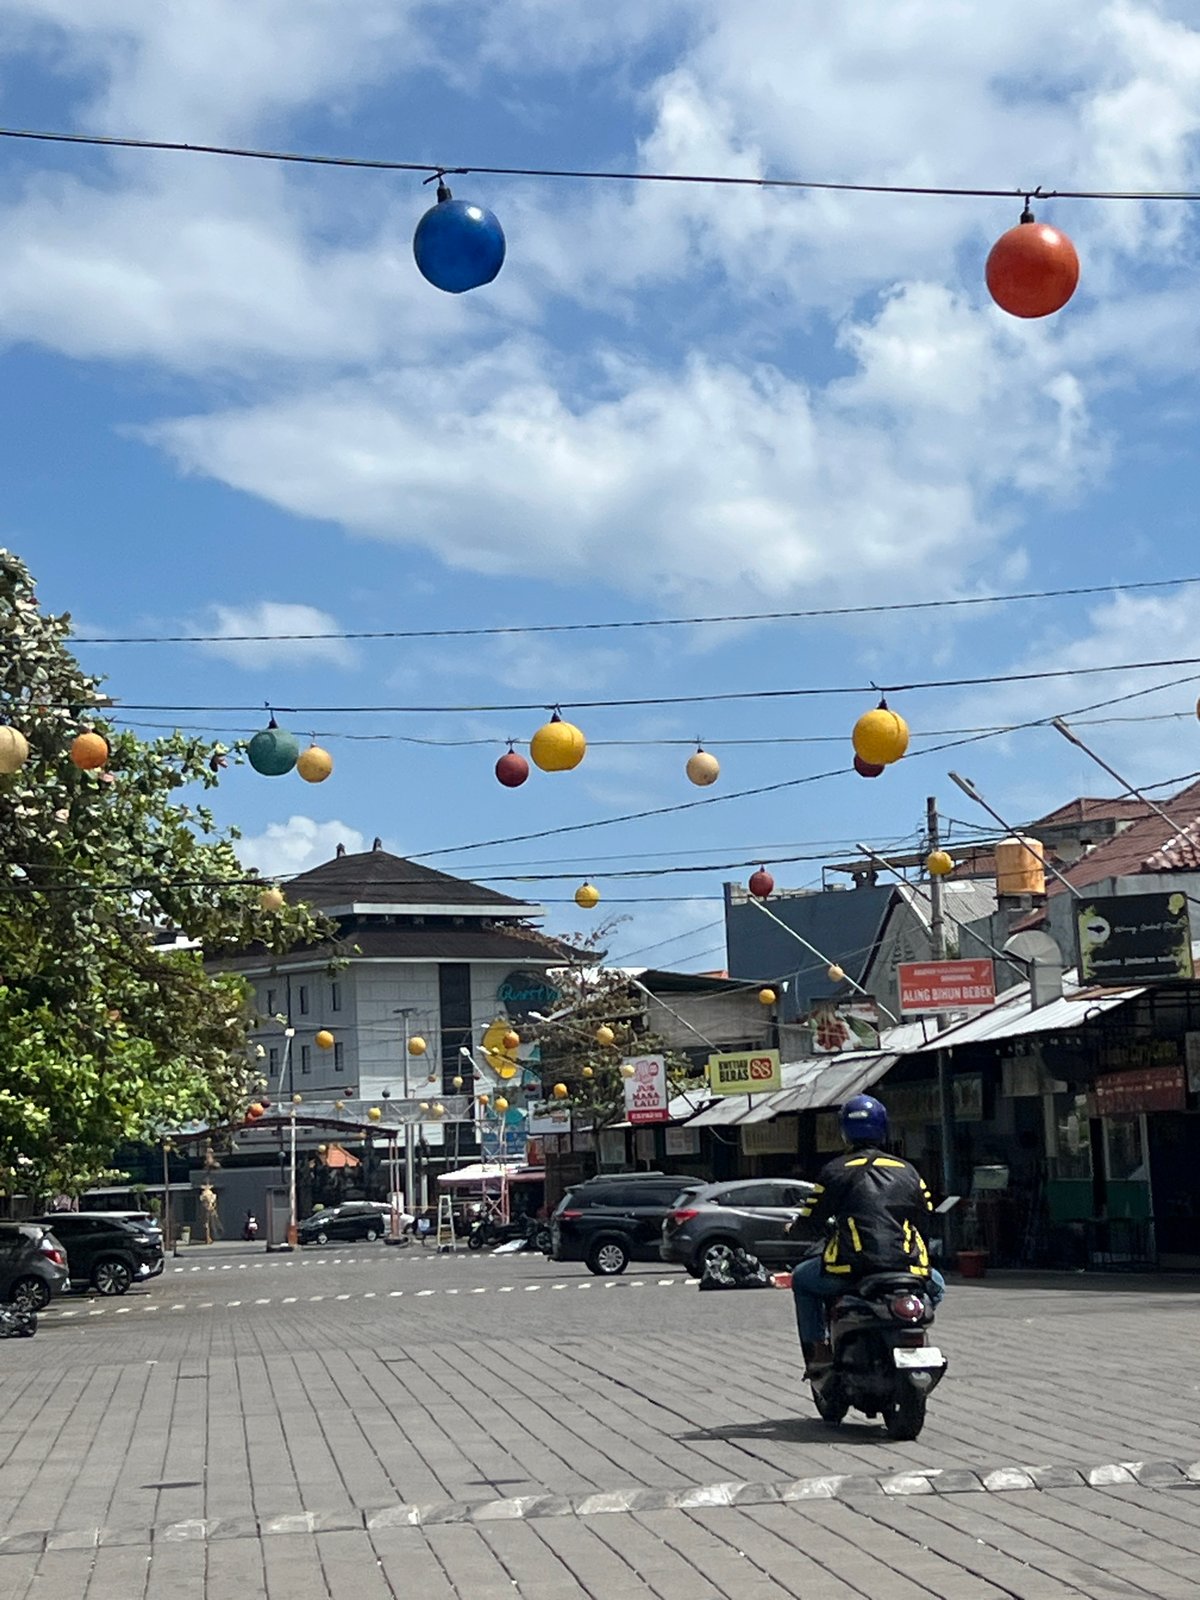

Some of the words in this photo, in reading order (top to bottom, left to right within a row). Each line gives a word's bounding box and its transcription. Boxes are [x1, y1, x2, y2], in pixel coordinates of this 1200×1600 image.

[903, 988, 931, 1002] ALING
[932, 987, 961, 1001] BIHUN
[962, 985, 994, 999] BEBEK
[634, 1100, 659, 1108] LALU
